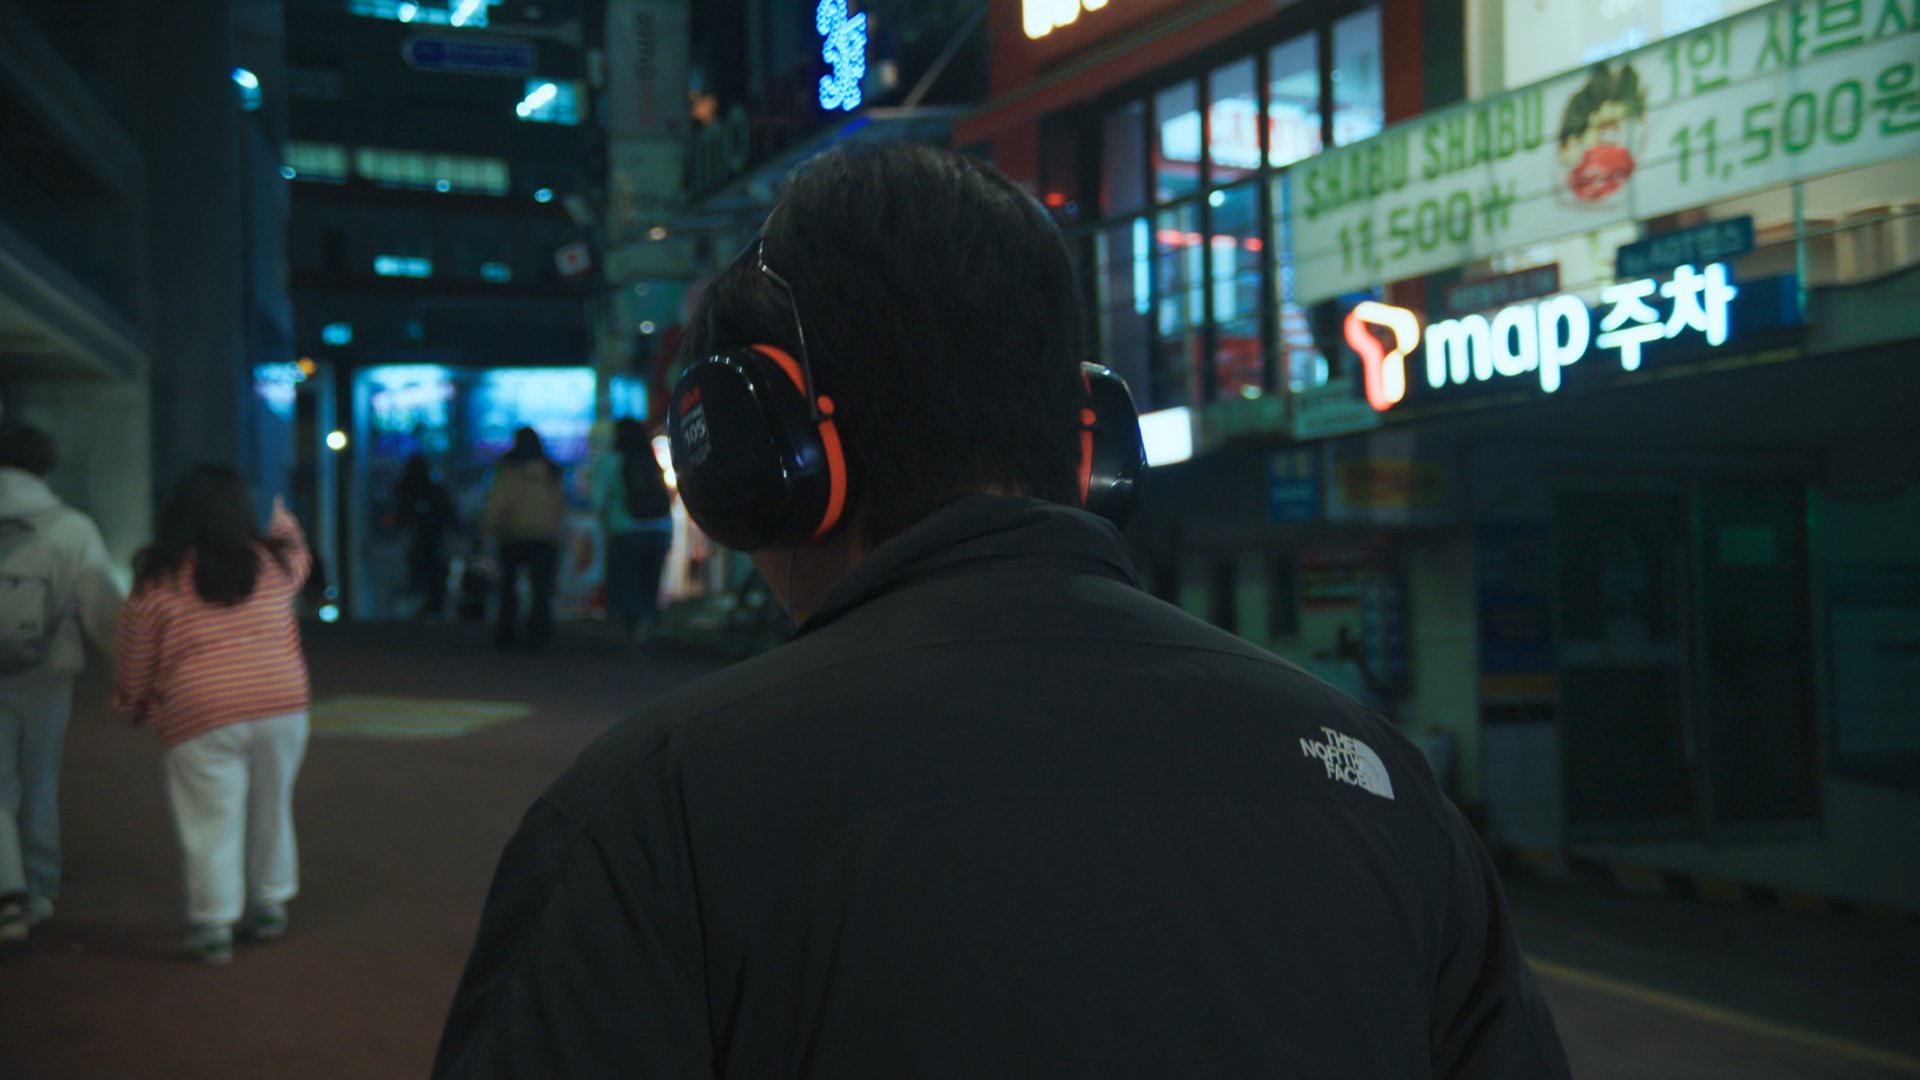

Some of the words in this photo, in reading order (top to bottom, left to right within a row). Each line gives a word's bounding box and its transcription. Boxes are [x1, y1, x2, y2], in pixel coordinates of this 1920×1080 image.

[1303, 133, 1409, 221] SHABU
[1423, 89, 1544, 181] SHABU
[1424, 294, 1591, 393] map
[1596, 262, 1739, 371] 주차
[1300, 737, 1360, 772] NORTH
[1321, 726, 1358, 754] THE
[1323, 757, 1368, 789] FACE
